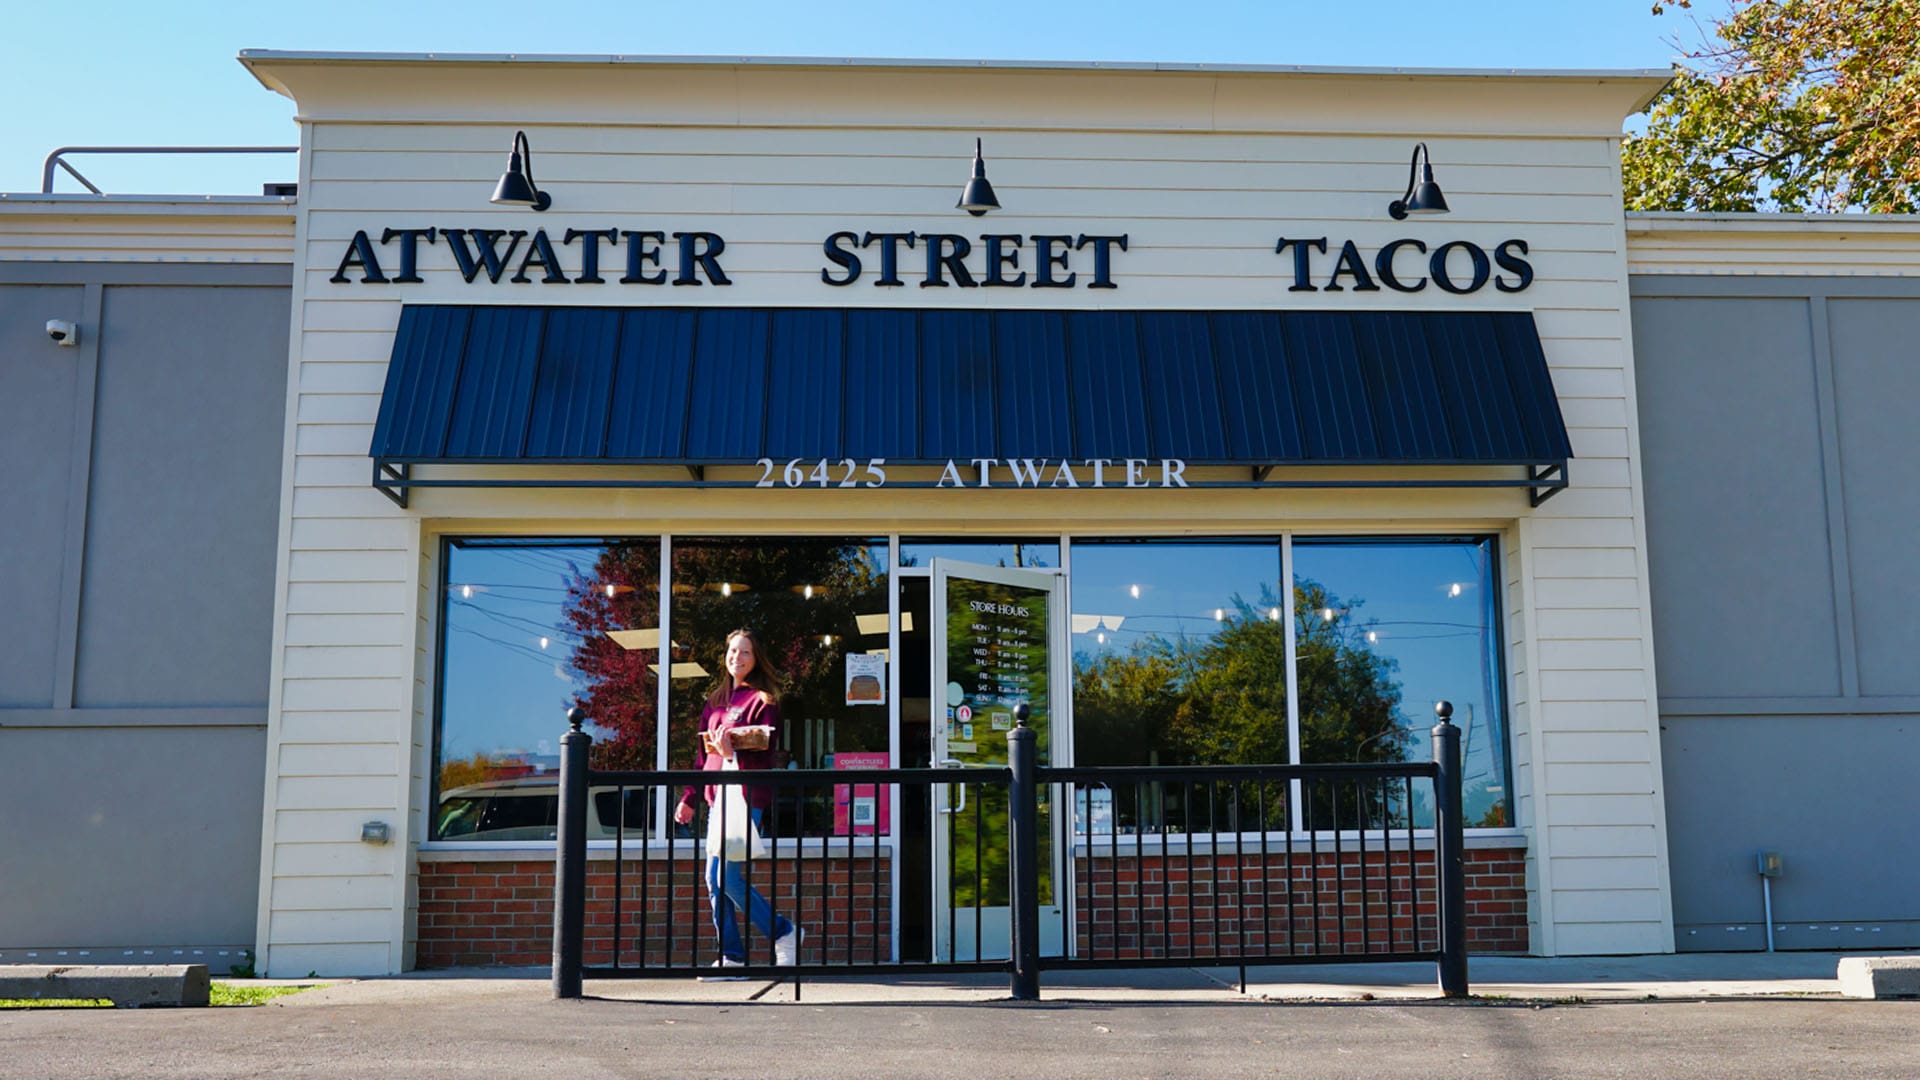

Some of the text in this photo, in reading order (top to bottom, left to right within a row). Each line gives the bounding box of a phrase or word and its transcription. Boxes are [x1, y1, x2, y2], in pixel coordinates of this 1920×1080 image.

[329, 226, 1534, 295] ATWATER STREET TACOS
[755, 458, 1190, 488] 26425 ATWATER
[970, 600, 1029, 617] STORE HOURS
